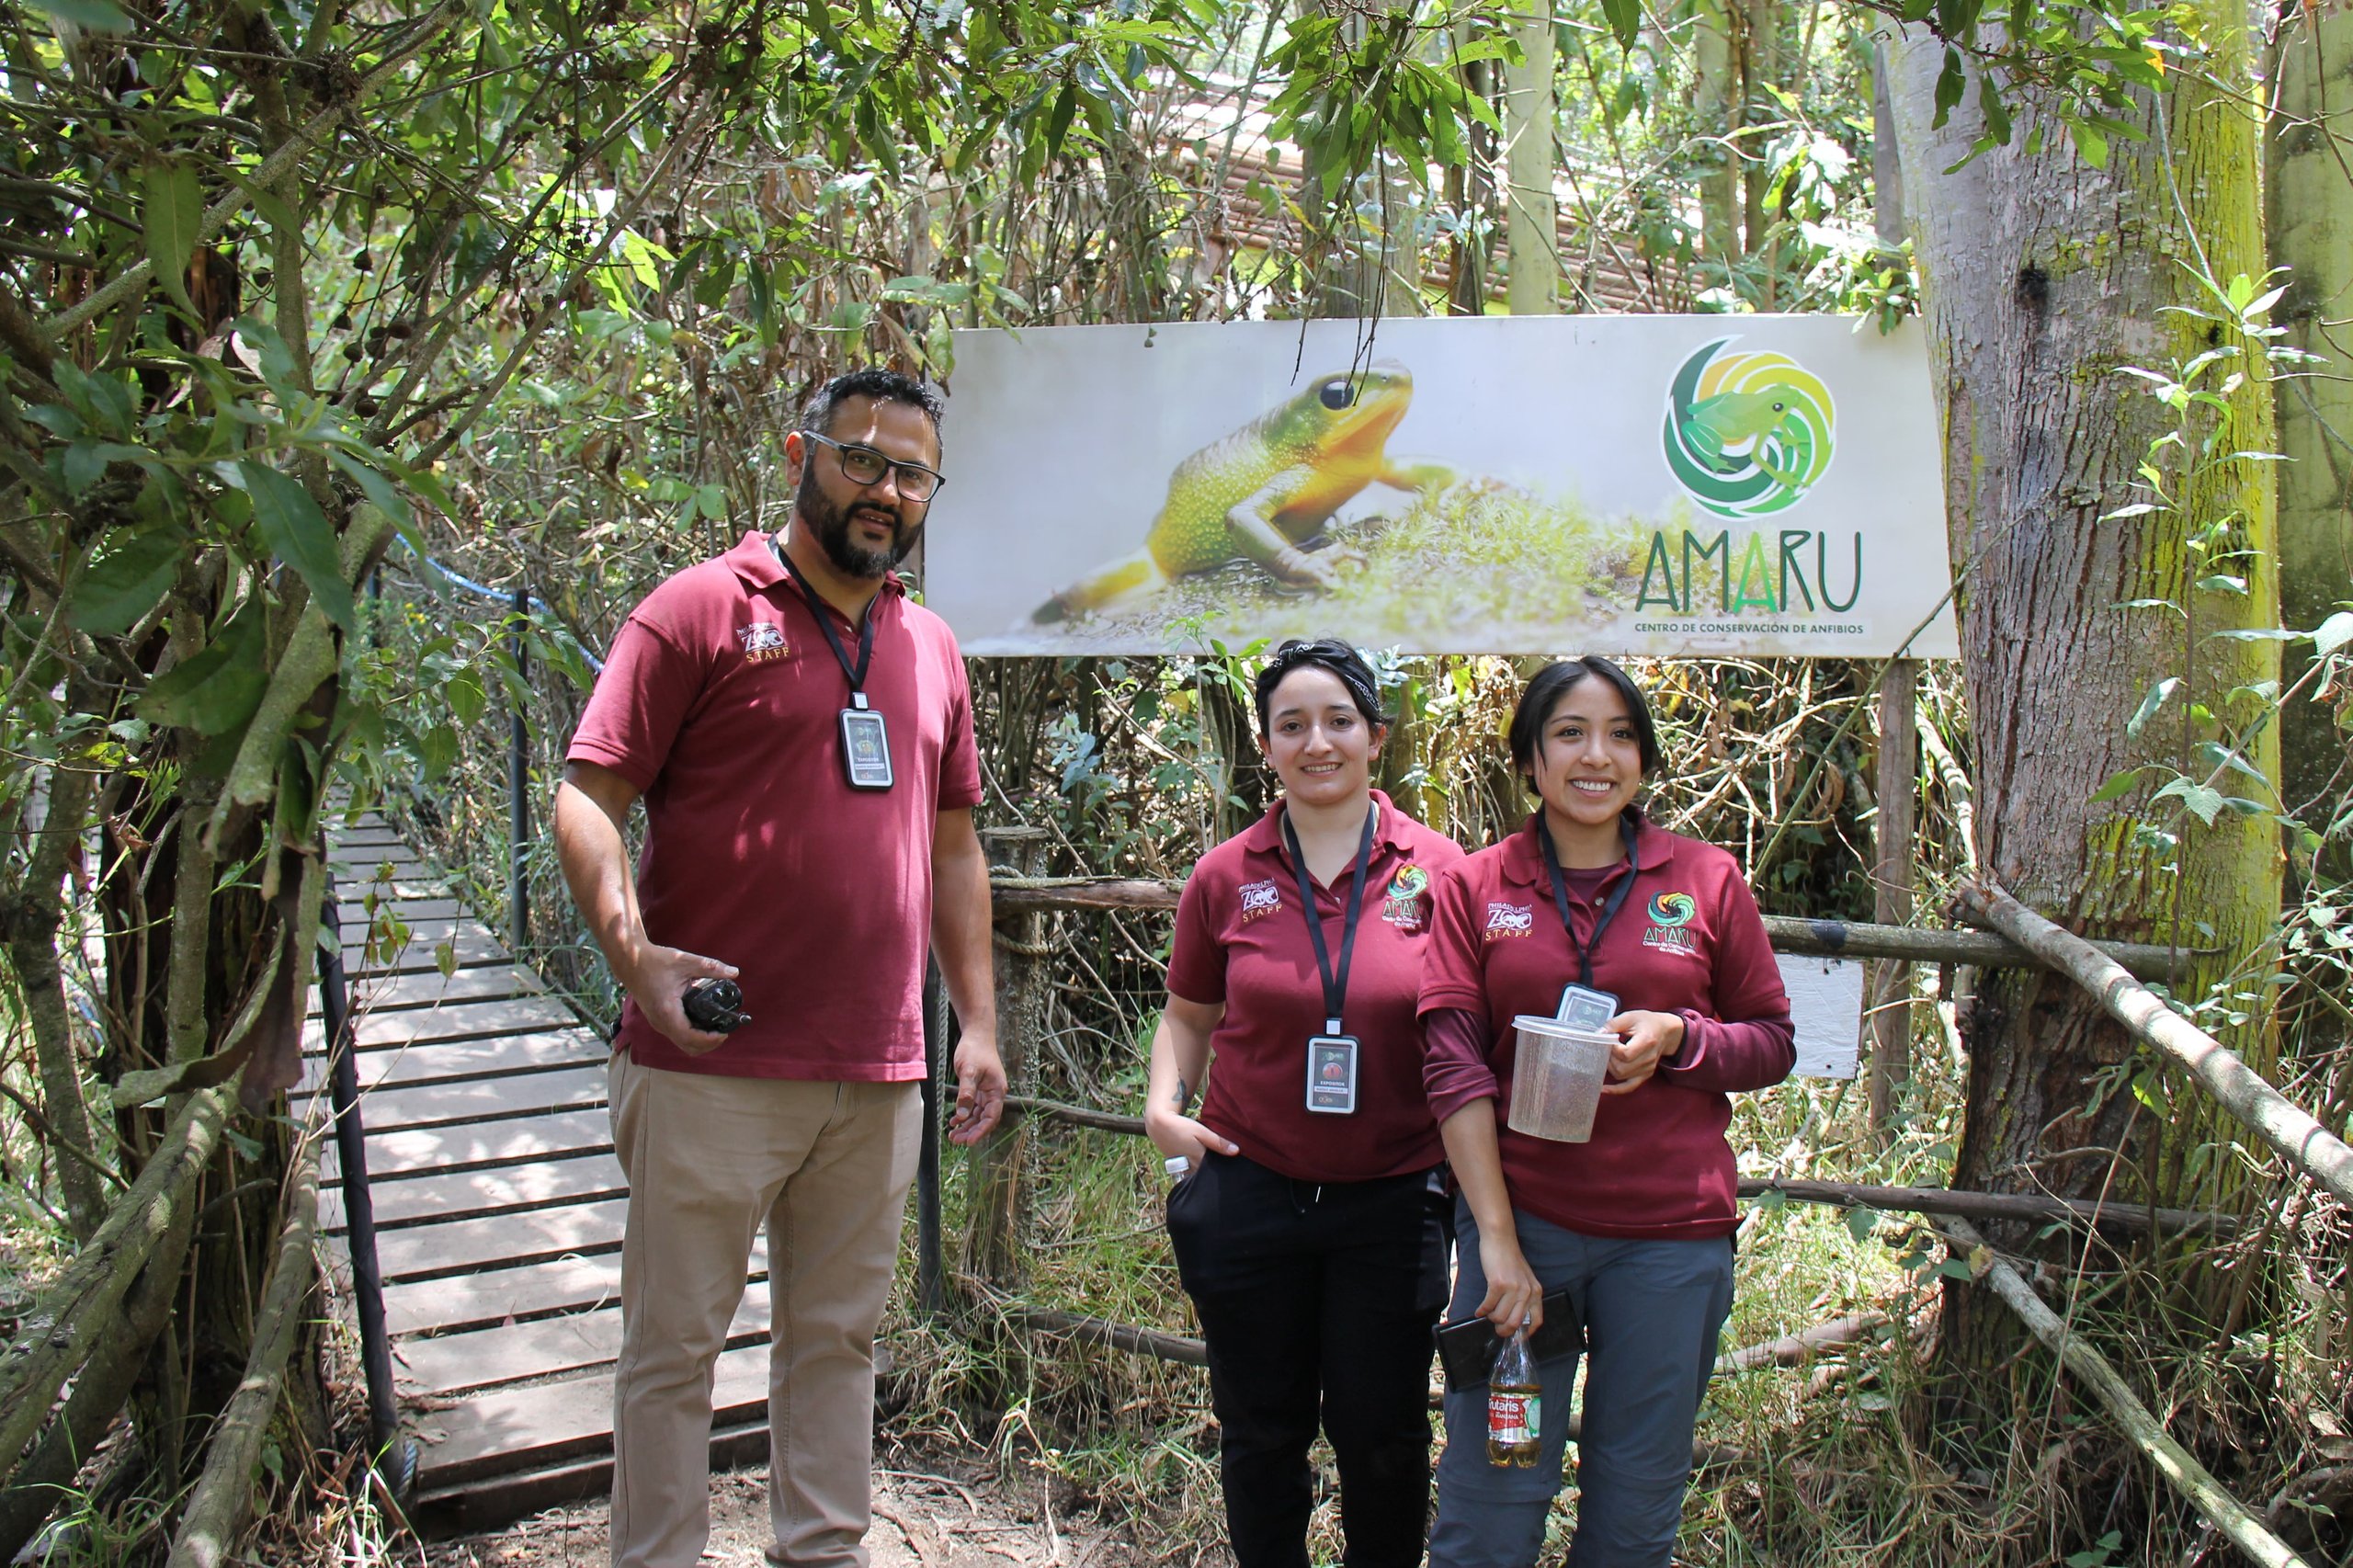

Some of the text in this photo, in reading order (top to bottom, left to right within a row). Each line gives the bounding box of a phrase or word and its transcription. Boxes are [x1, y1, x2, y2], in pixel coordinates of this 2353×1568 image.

[1634, 529, 1861, 612] AMARU
[1634, 621, 1864, 634] CENTRO DE CONSERVACIÓN DE ANFIBIOS
[741, 630, 784, 653] ZOO
[745, 647, 790, 662] STAFF
[1241, 886, 1279, 912] ZOO
[1243, 904, 1282, 923] STAFF
[1487, 909, 1532, 928] ZOO
[1485, 928, 1533, 941] STAFF
[1643, 926, 1698, 949] AMARU
